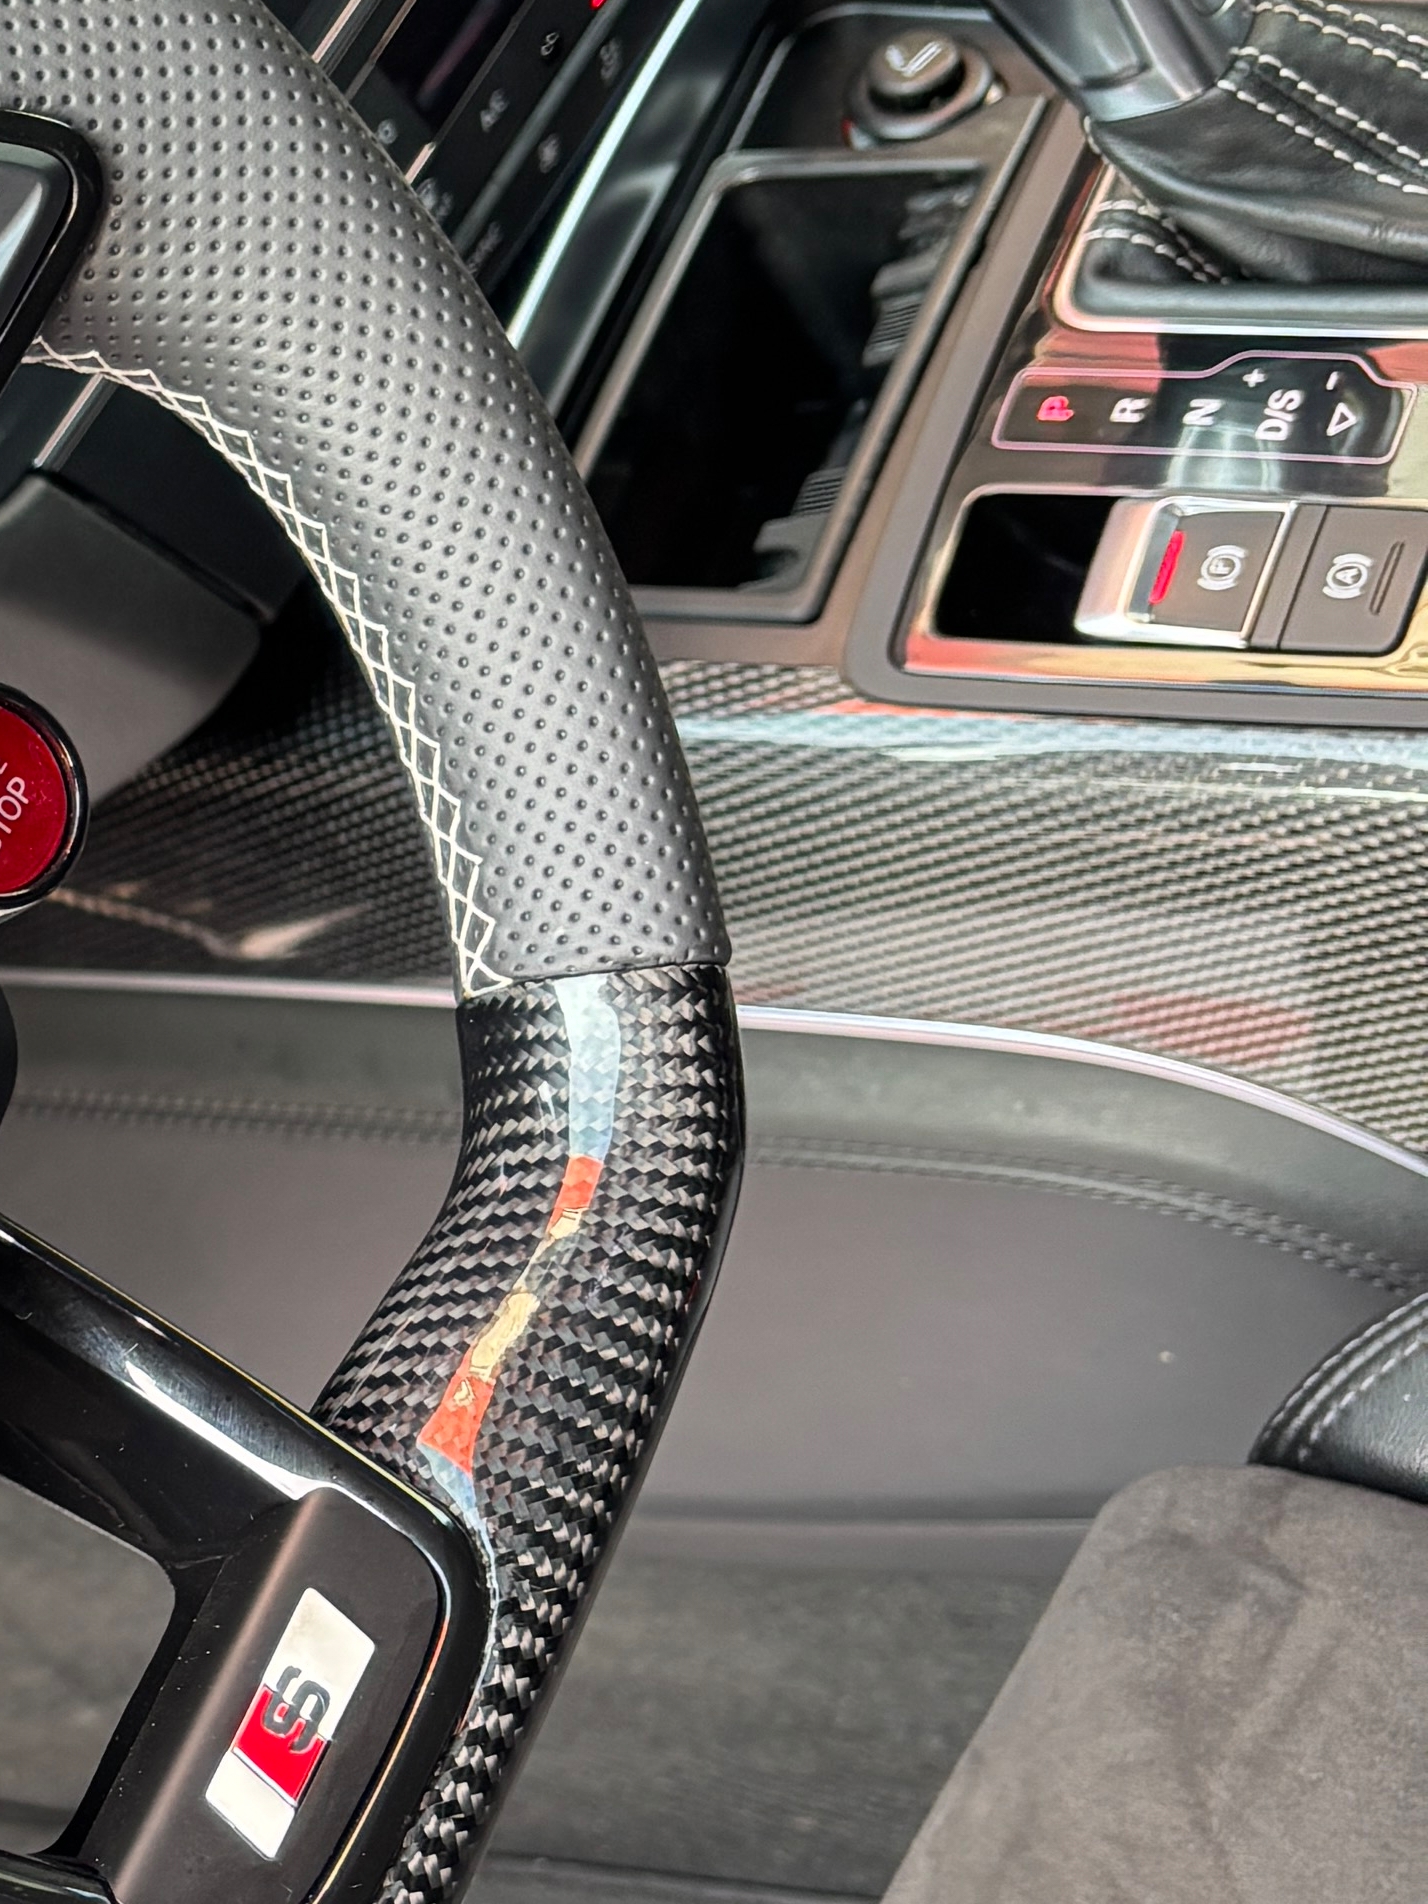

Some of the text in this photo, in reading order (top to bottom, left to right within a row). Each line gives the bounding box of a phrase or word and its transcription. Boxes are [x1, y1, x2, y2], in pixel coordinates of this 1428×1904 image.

[1109, 397, 1150, 423] R
[1182, 398, 1225, 427] N
[1254, 388, 1305, 441] D/S
